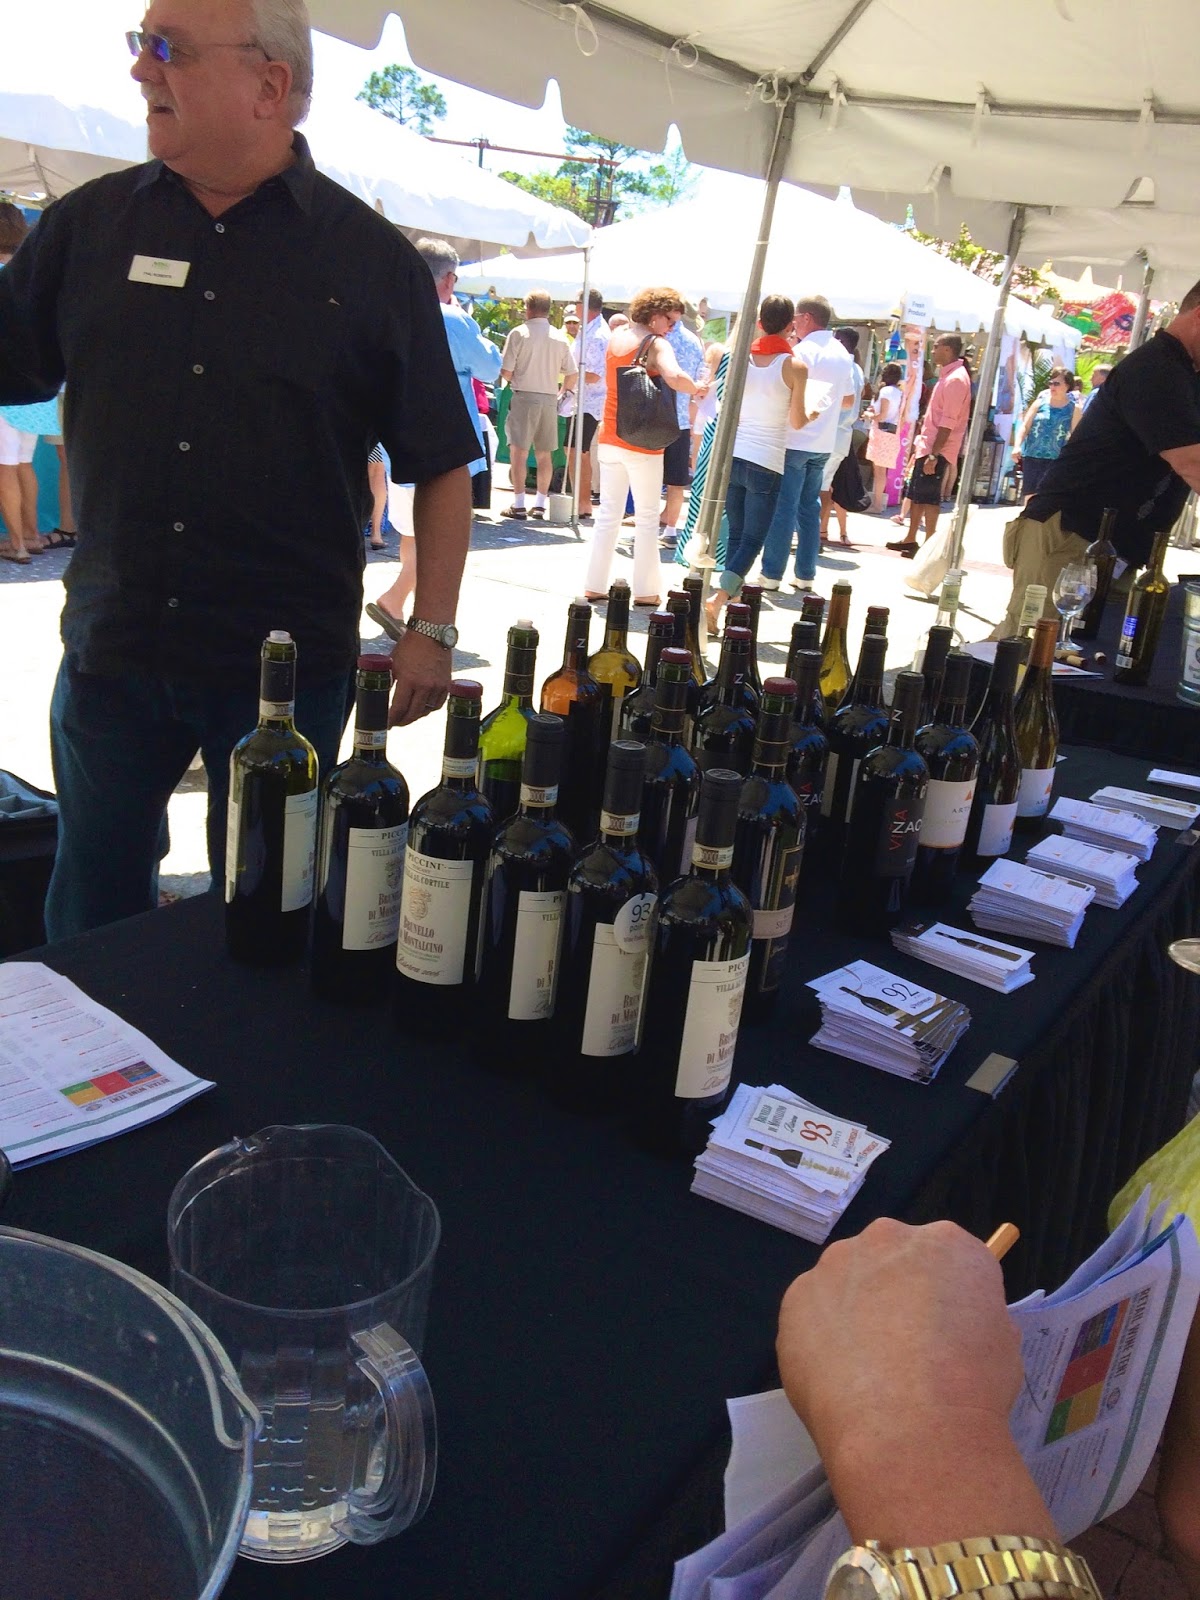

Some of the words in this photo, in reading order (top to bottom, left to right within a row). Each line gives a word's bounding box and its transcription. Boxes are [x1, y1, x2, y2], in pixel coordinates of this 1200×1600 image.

[908, 309, 926, 317] Produce
[577, 638, 585, 648] Z
[734, 673, 743, 684] Z
[892, 710, 903, 722] Z
[408, 852, 444, 871] PICCINI
[420, 876, 450, 889] CORTILE
[631, 902, 651, 923] 93
[403, 915, 435, 938] BRUNELLO
[403, 930, 443, 954] MONTALCINO
[728, 960, 747, 973] PICC
[881, 983, 920, 1001] 92
[799, 1120, 833, 1146] 93
[1131, 1287, 1151, 1322] RETAIL
[1123, 1323, 1140, 1352] WINE
[1114, 1352, 1132, 1377] TENT
